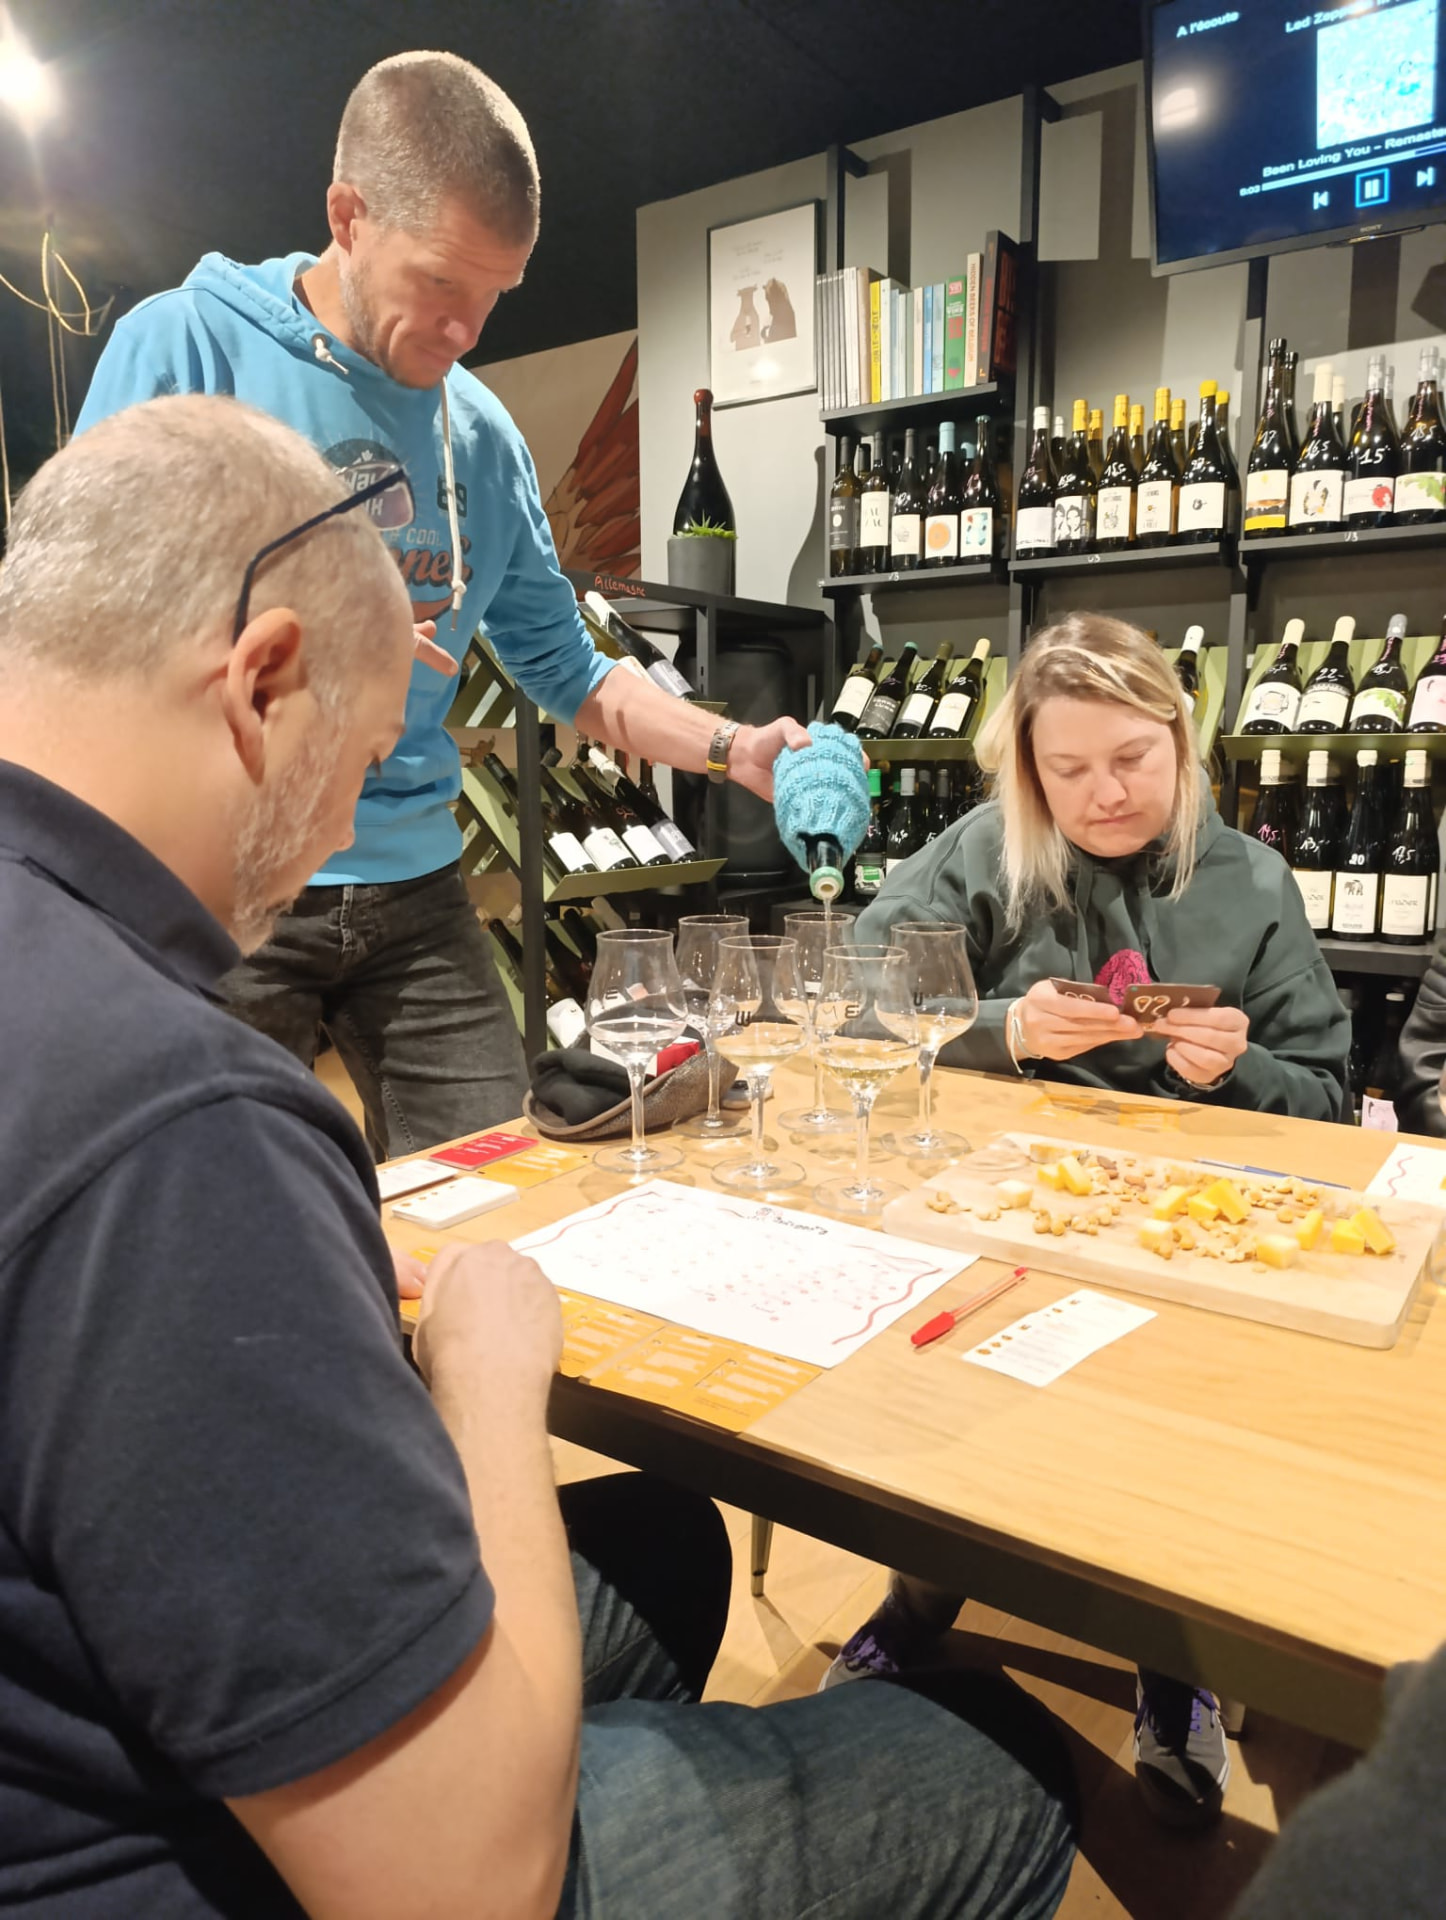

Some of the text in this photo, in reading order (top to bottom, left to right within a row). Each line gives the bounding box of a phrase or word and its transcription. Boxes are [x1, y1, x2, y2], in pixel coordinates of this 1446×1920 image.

[1285, 15, 1311, 33] Led
[1262, 162, 1295, 178] Been
[1298, 151, 1342, 170] Loving
[1344, 145, 1371, 159] You
